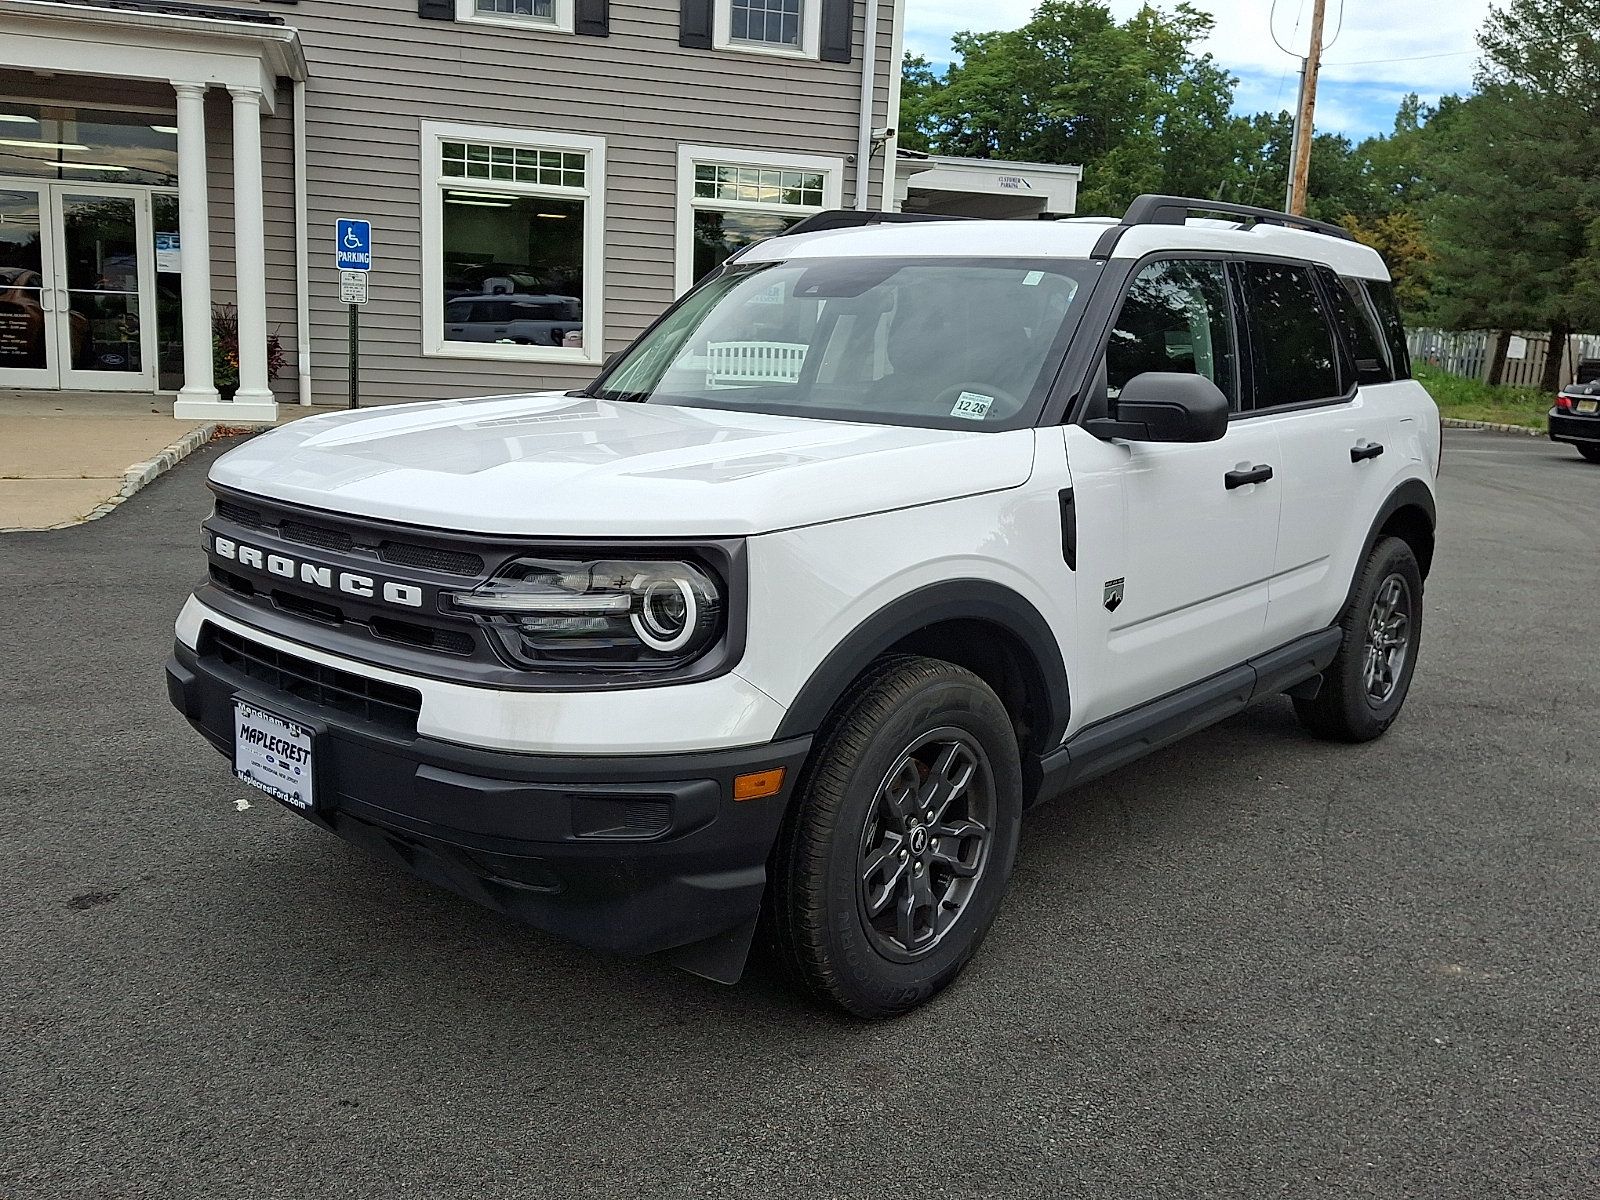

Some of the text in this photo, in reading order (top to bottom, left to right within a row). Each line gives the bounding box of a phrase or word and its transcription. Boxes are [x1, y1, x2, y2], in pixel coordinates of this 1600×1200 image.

[338, 251, 369, 263] PARKING
[957, 400, 986, 414] 12 28
[215, 536, 422, 607] BRONCO
[239, 723, 311, 766] MAPLECREST
[237, 771, 306, 810] MaplecrestFord.com
